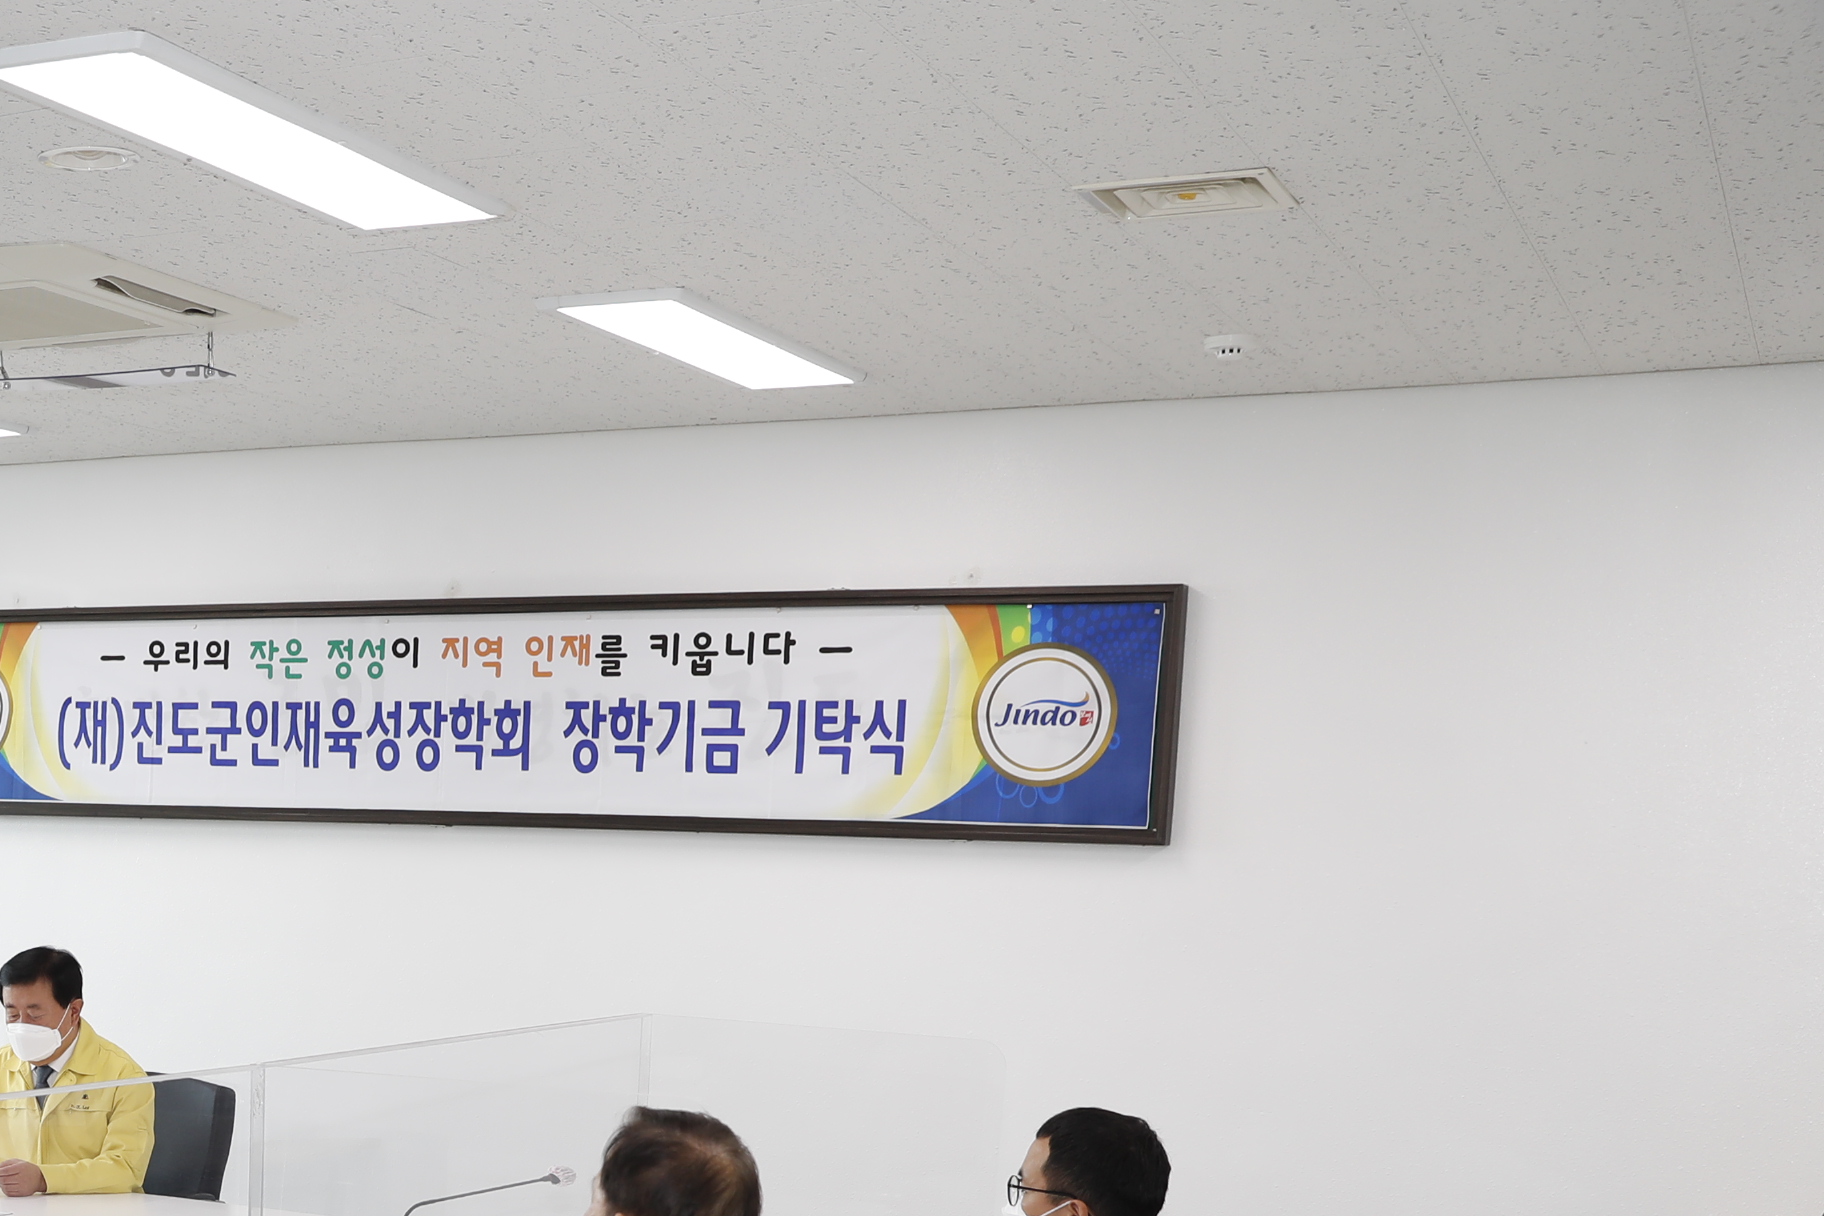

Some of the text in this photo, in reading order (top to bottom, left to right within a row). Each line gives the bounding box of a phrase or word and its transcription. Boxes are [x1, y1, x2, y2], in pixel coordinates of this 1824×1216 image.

[142, 630, 797, 679] 우리의 작은 정성이 지역 인재를 키웁니다
[57, 697, 908, 775] (재)진도군인재육성장학회 장학기금 기탁식
